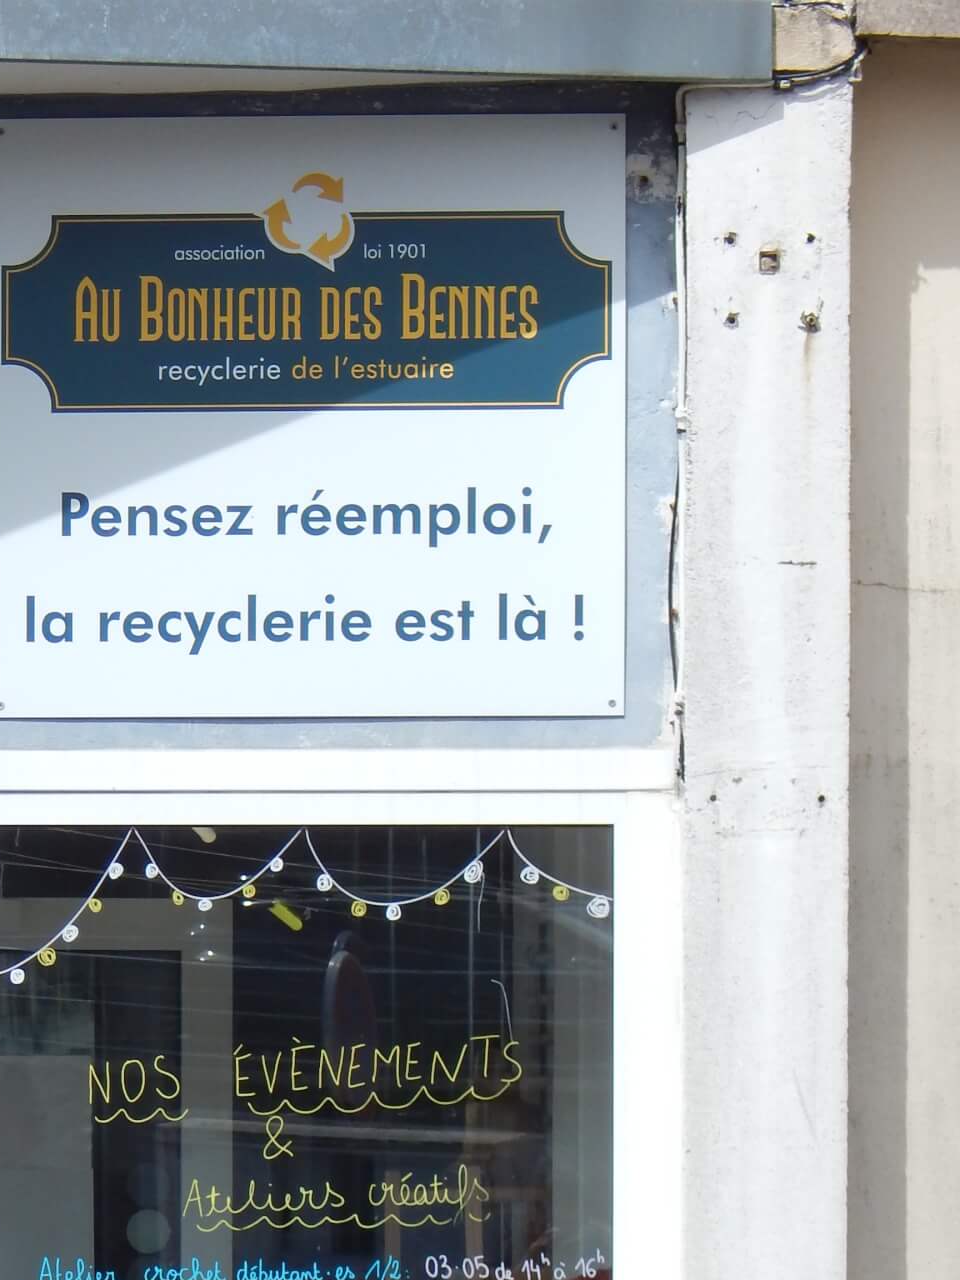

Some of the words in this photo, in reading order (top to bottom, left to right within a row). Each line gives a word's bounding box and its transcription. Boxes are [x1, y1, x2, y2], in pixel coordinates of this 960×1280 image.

[174, 245, 265, 261] association
[363, 243, 383, 259] loi
[388, 242, 428, 259] 1901
[73, 275, 121, 343] AU
[138, 274, 303, 343] BONHEUR
[320, 284, 383, 341] DES
[400, 272, 539, 340] BENNES
[157, 357, 281, 387] recyclerie
[291, 357, 323, 381] de
[334, 356, 455, 381] l'estuaire
[60, 492, 254, 538] Pensez
[276, 486, 553, 548] réemploi,
[25, 595, 73, 643] la
[98, 594, 373, 657] recyclerie
[395, 598, 474, 642] est
[498, 592, 548, 642] là
[88, 1055, 180, 1105] NOS
[233, 1034, 522, 1098] ÉVÈNEMENTS
[263, 1115, 294, 1160] &
[183, 1180, 346, 1217] Ateliers
[368, 1164, 490, 1222] créatifs
[495, 1261, 514, 1280] de
[553, 1263, 566, 1280] à
